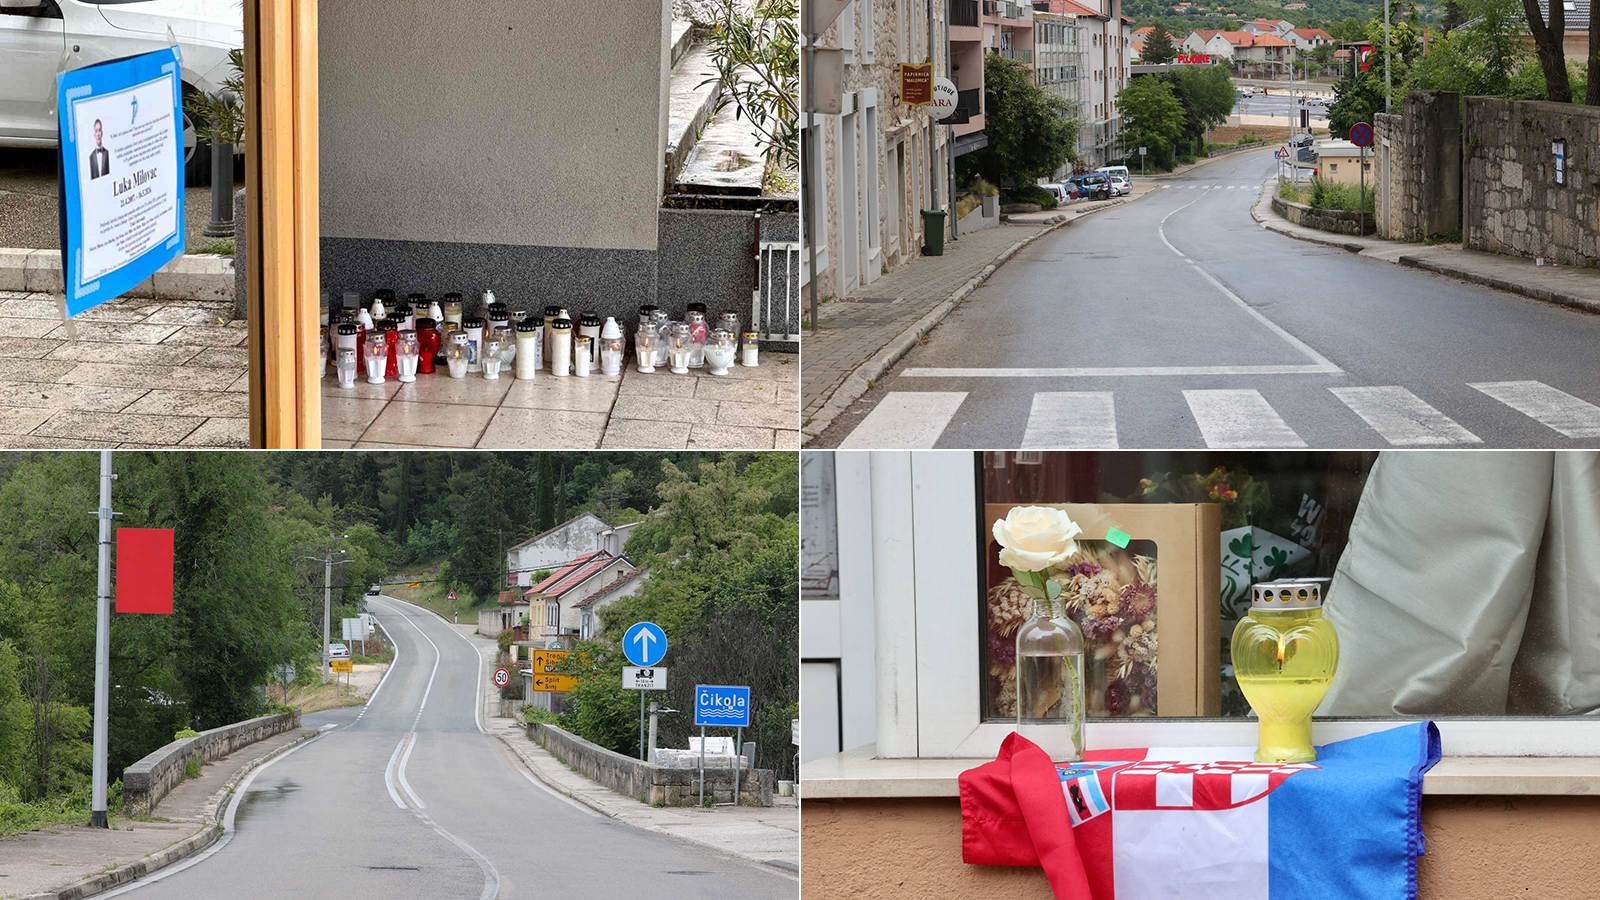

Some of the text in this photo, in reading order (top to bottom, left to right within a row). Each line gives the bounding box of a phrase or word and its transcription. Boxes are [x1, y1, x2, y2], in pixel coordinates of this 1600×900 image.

[933, 85, 955, 96] UTIQUE
[928, 99, 952, 107] ARA
[113, 167, 158, 197] Luka Milovac
[497, 673, 507, 683] 50
[700, 689, 745, 707] Čikola
